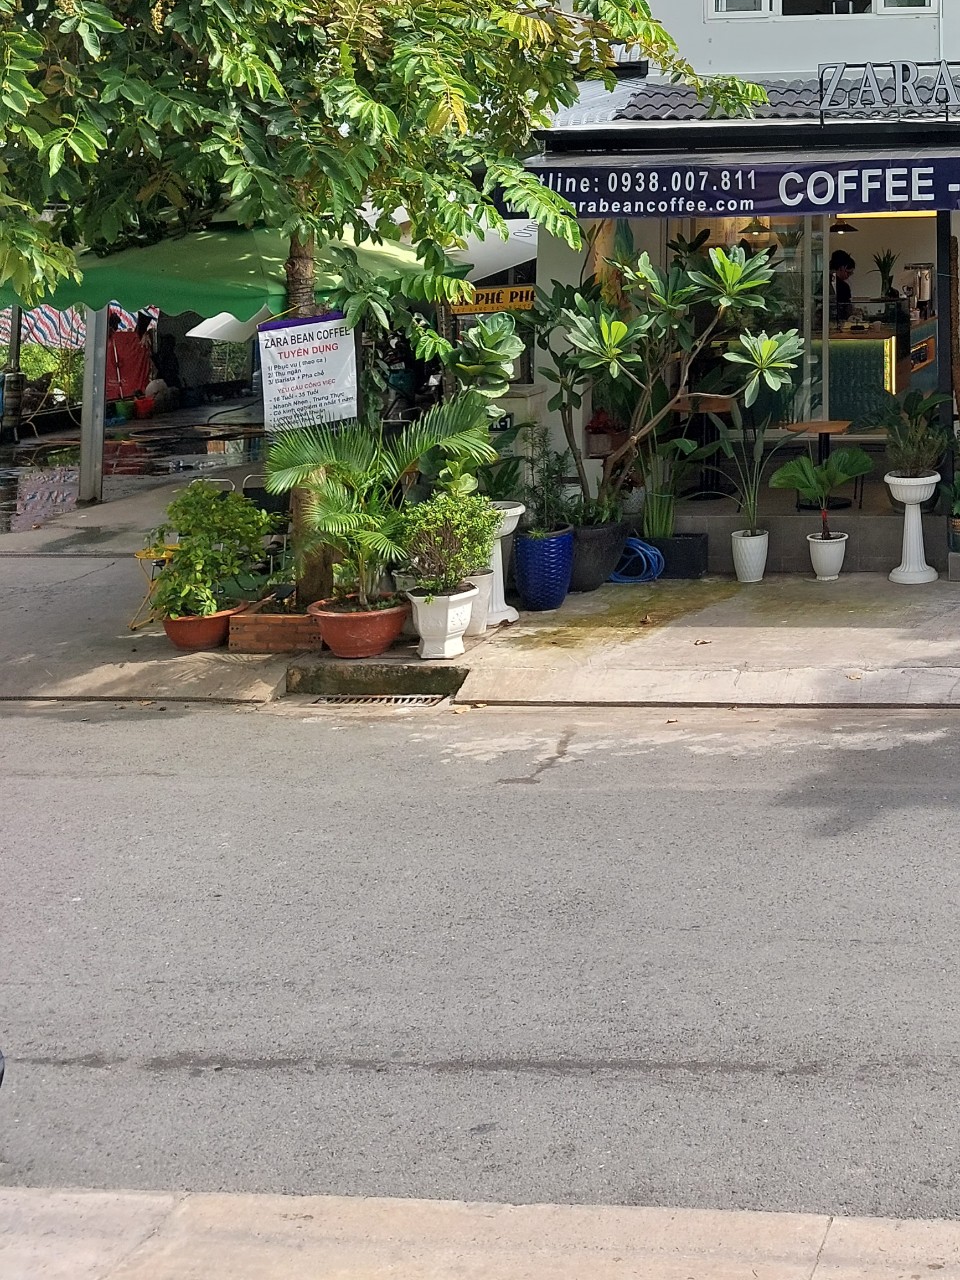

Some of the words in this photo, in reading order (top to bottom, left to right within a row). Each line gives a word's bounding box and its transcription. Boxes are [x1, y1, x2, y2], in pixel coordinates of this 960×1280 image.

[607, 170, 756, 192] 0938.007.811
[778, 166, 934, 206] COFFEE
[475, 290, 504, 305] PHÊ
[265, 337, 288, 349] ZARA
[290, 332, 314, 344] BEAN
[317, 327, 350, 340] COFFEE
[312, 343, 338, 354] DỤNG
